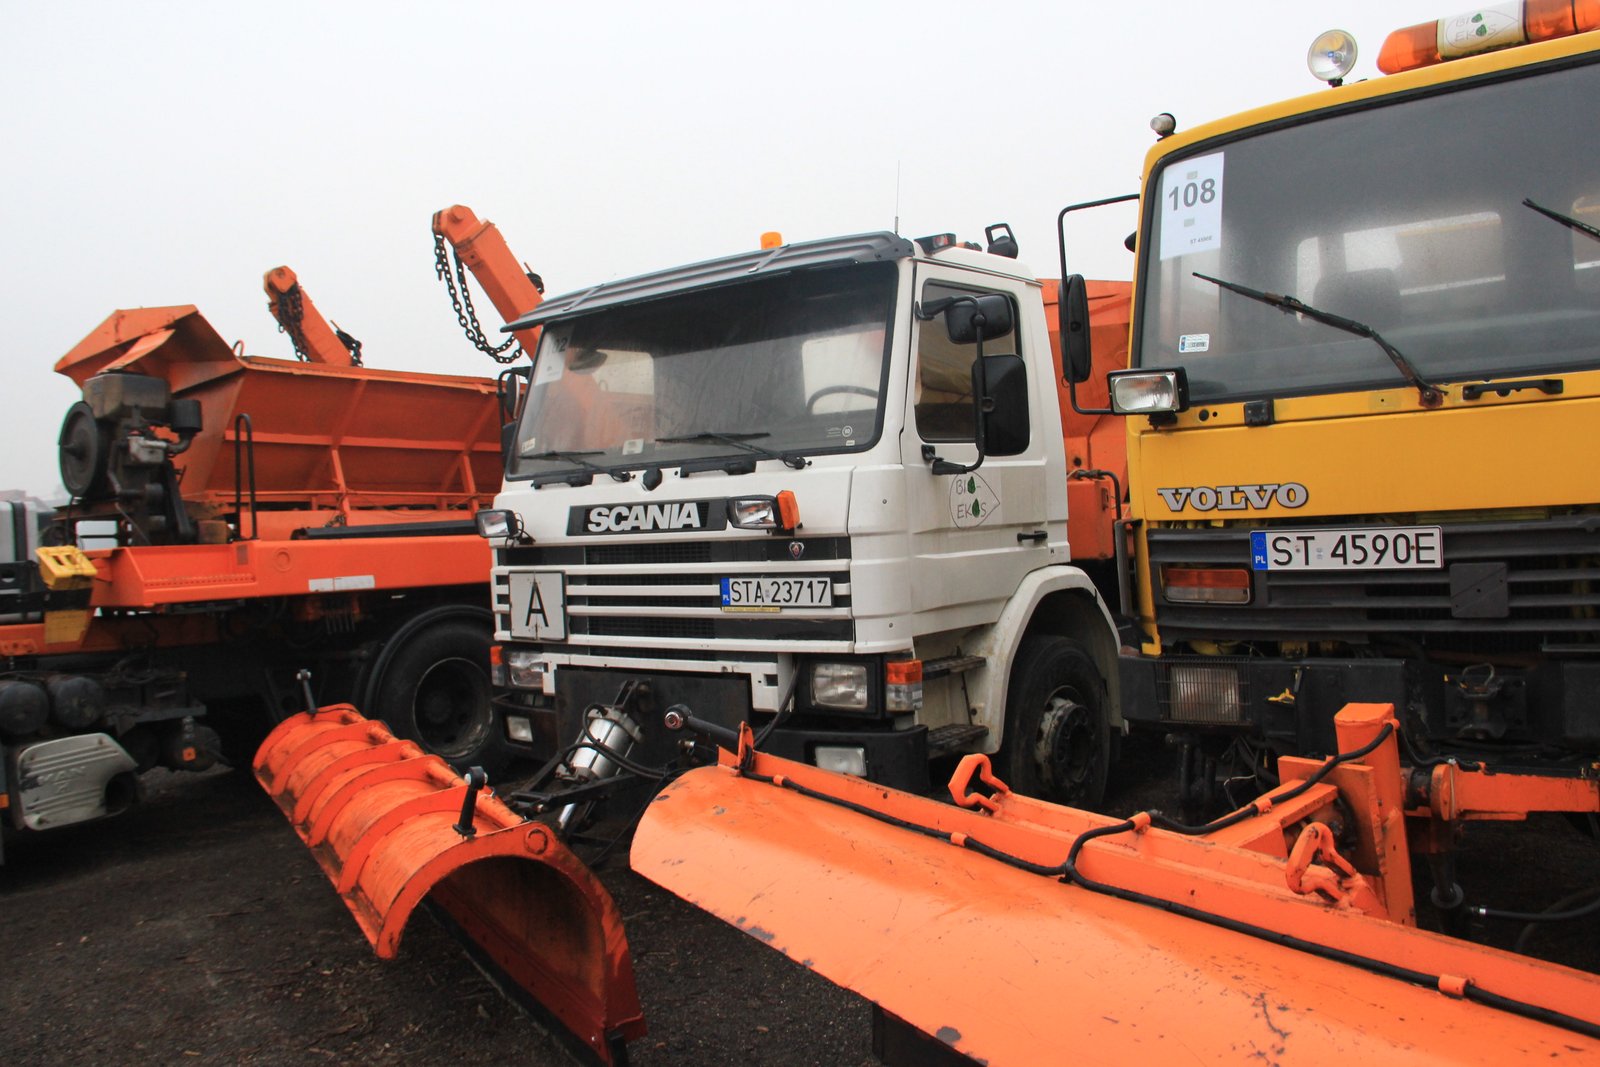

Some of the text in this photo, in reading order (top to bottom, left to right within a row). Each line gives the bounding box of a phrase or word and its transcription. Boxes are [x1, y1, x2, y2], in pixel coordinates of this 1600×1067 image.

[1168, 178, 1216, 212] 108
[1157, 482, 1309, 512] VOLVO
[587, 502, 701, 533] SCANIA
[1255, 555, 1266, 564] PL
[1271, 532, 1436, 567] ST 4590E
[525, 579, 549, 628] A
[731, 580, 828, 604] STA 23717
